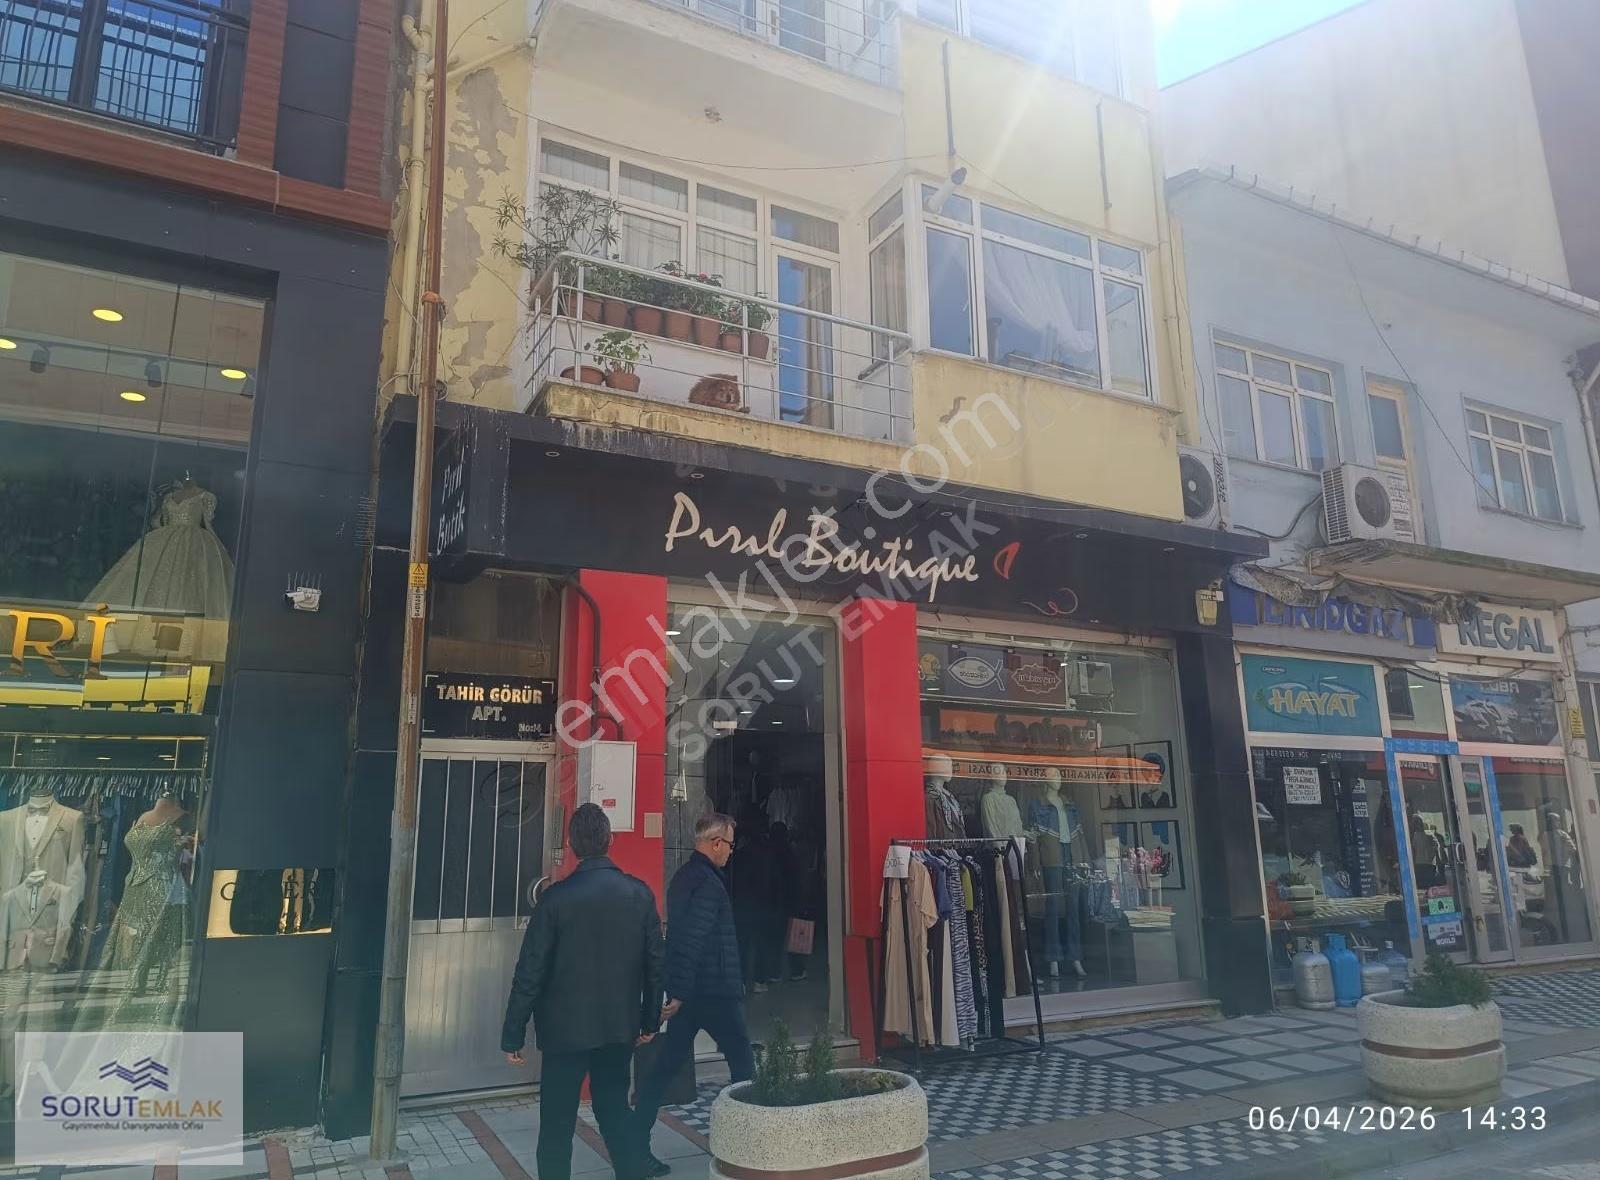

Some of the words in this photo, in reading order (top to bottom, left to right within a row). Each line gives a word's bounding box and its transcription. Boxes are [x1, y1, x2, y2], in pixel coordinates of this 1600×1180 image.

[802, 514, 979, 603] Boutique
[1458, 610, 1554, 654] REGAL
[436, 682, 484, 702] TAHİR
[490, 684, 542, 704] GÖRÜR
[1268, 688, 1361, 718] HAYAT
[471, 705, 507, 722] APT.
